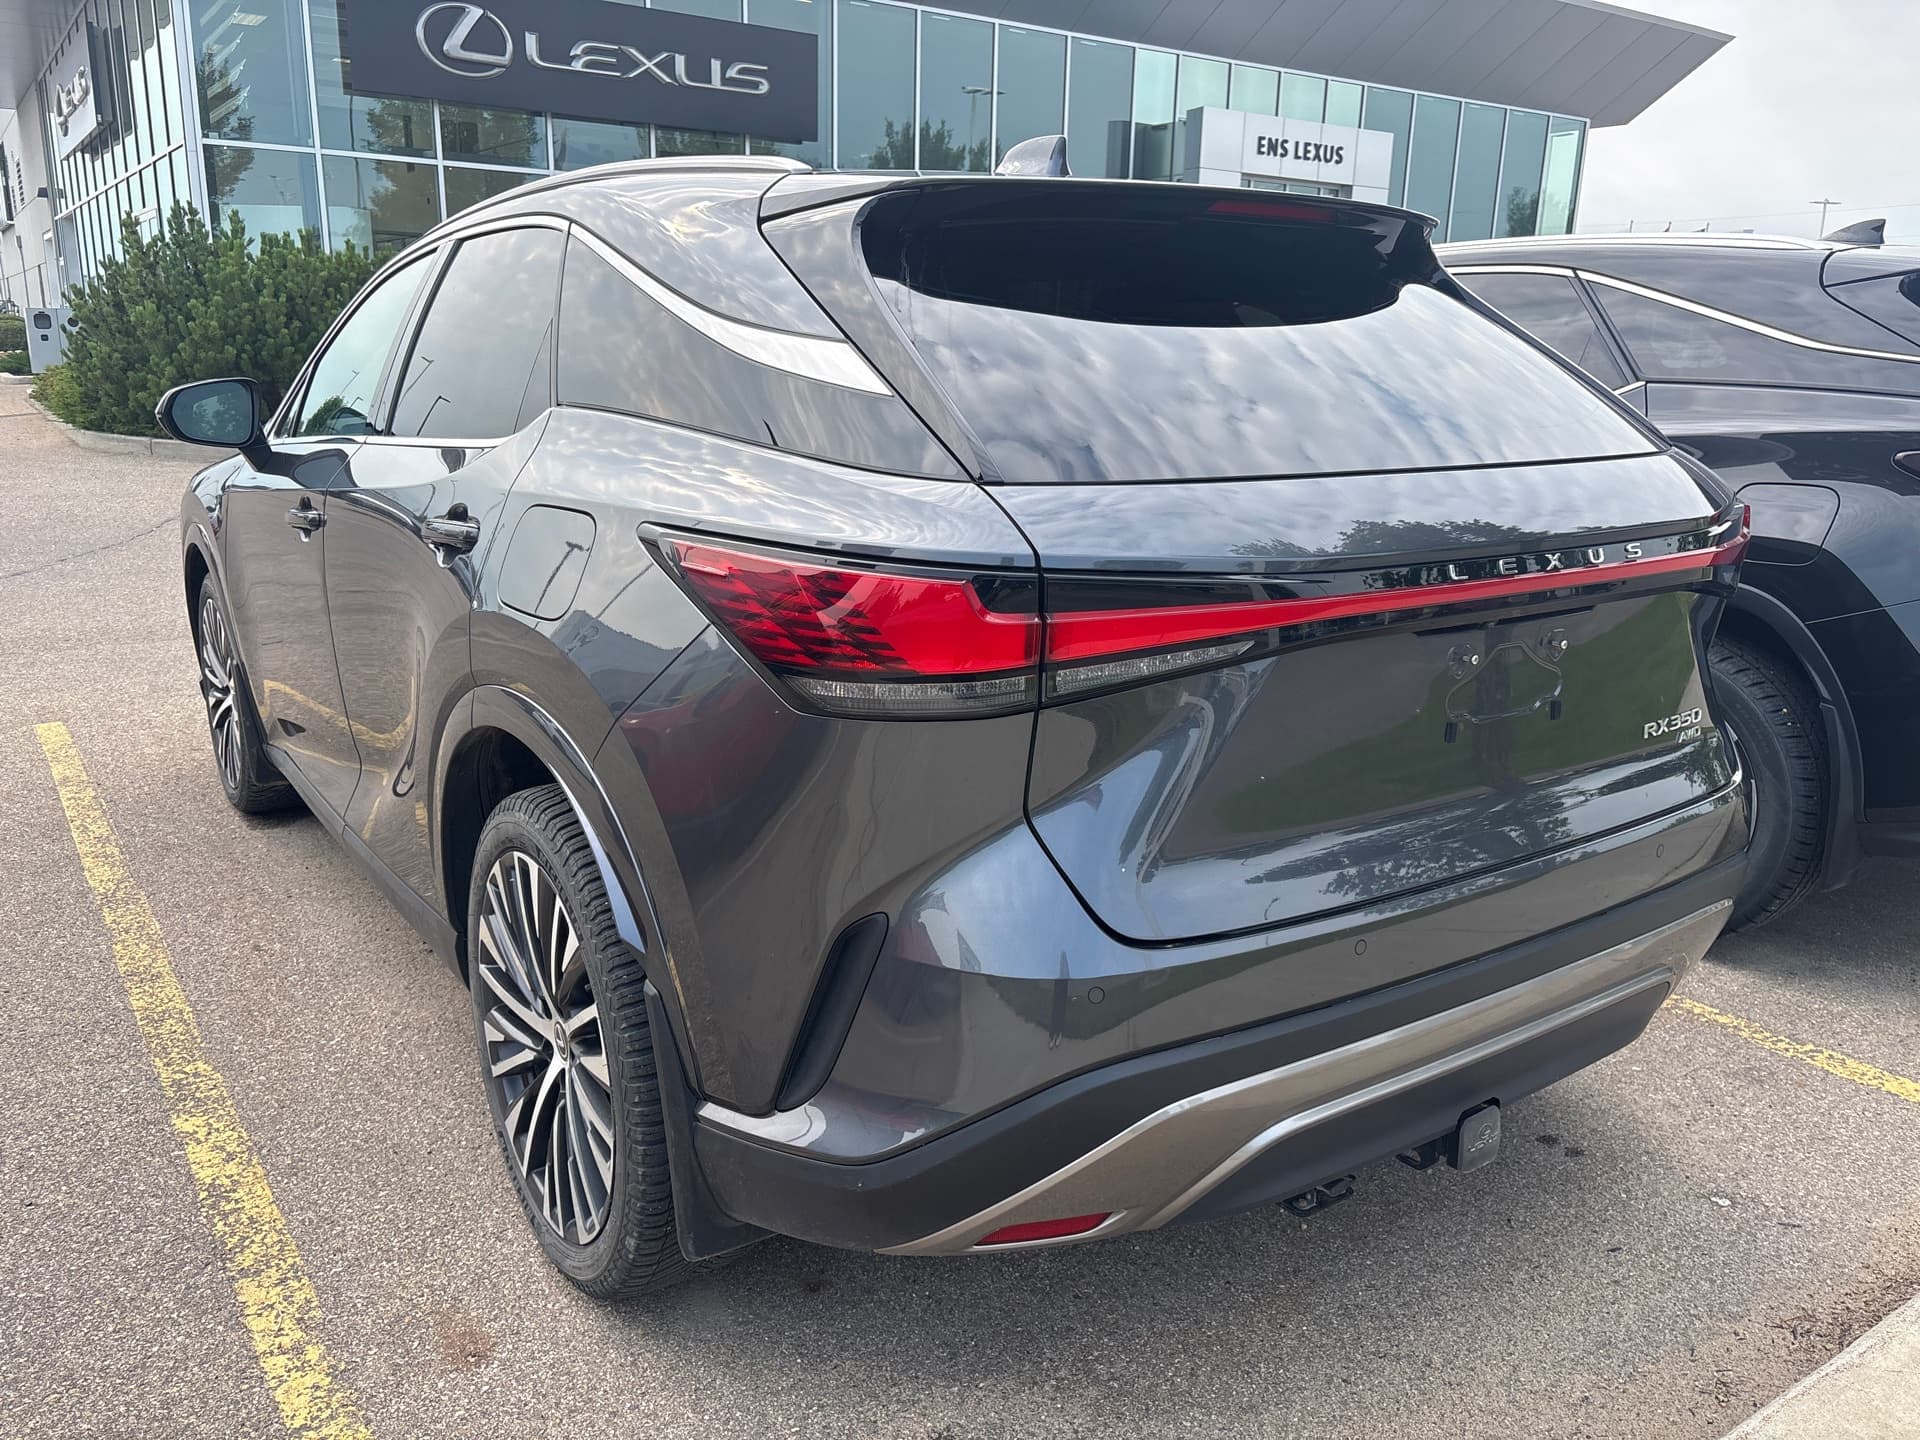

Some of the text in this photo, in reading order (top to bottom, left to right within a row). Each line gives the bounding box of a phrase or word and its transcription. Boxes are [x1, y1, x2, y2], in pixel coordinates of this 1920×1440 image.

[525, 31, 770, 95] LEXUS
[1257, 135, 1344, 165] ENS LEXUS
[1449, 542, 1643, 581] LEXUS
[1643, 707, 1702, 739] RX350
